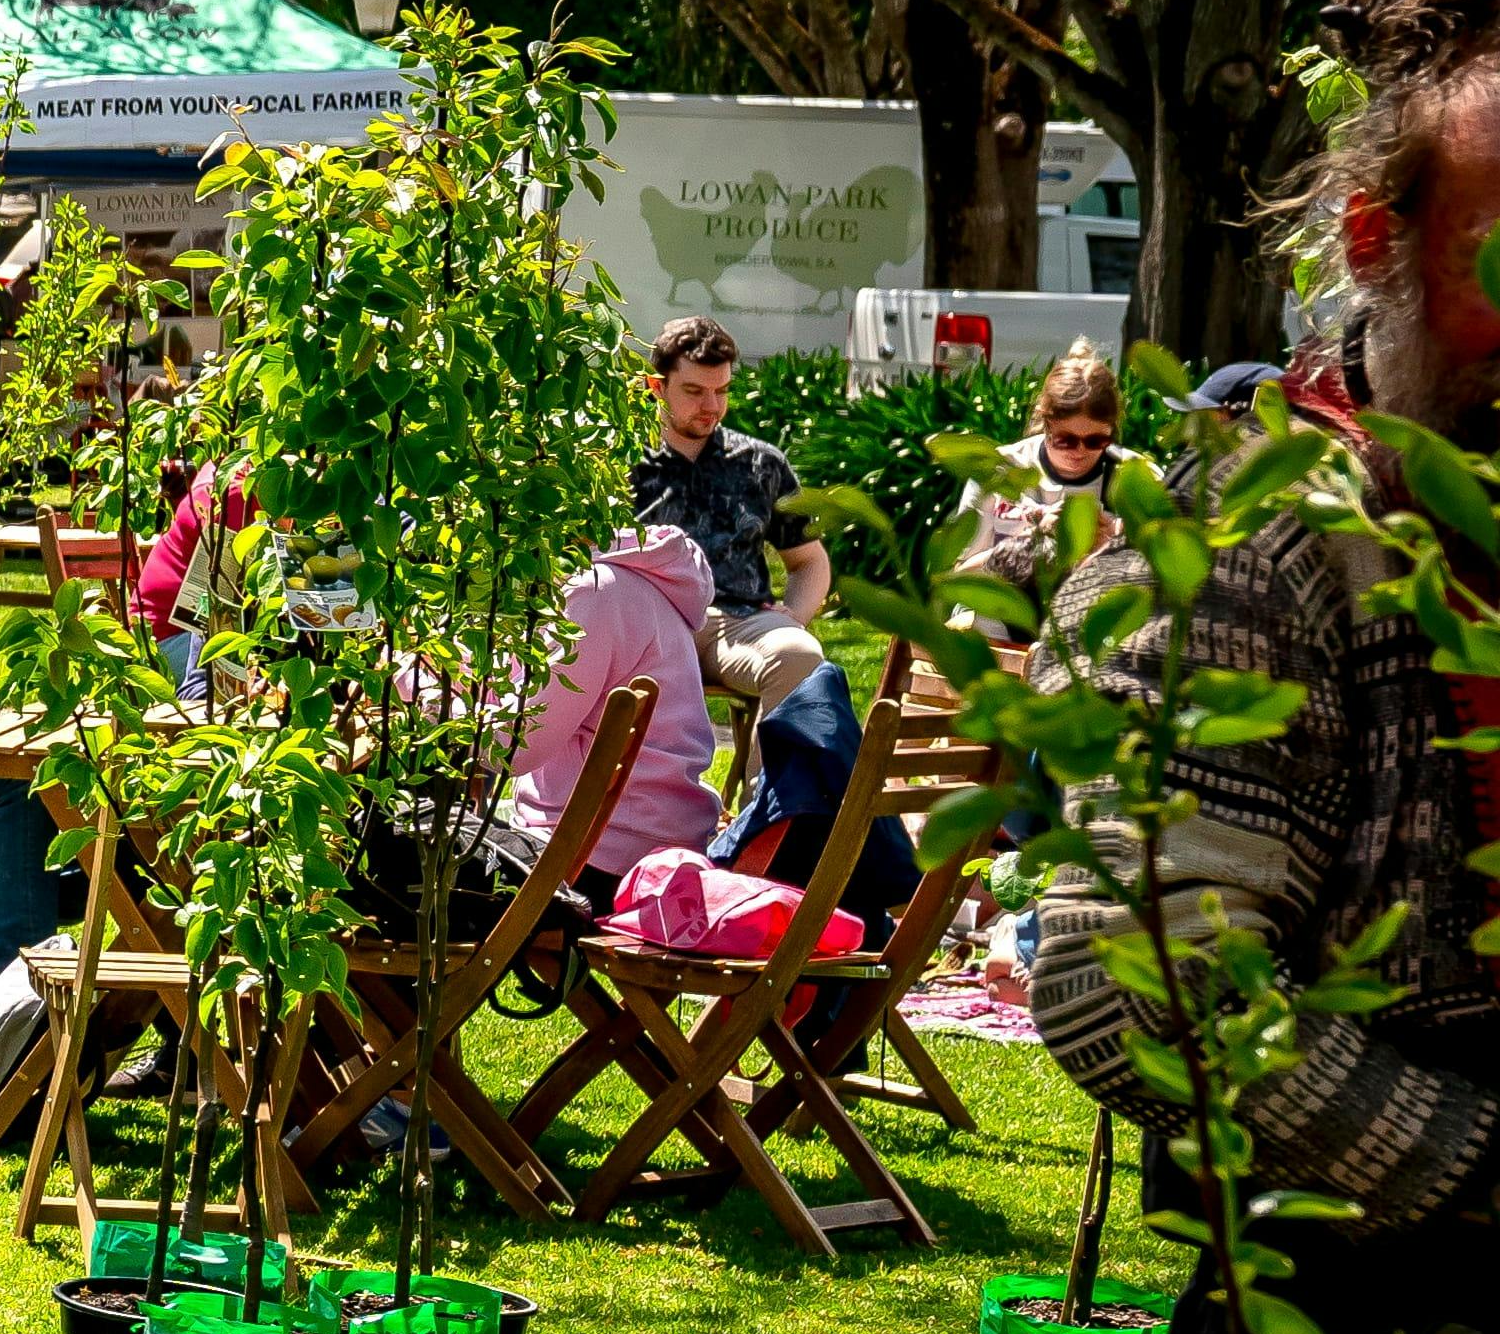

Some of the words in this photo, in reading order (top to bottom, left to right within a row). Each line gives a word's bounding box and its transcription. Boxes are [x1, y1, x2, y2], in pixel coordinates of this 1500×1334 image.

[37, 99, 95, 118] MEAT
[102, 97, 163, 116] FROM
[96, 192, 164, 212] LOWAN
[680, 180, 792, 206] LOWAN
[805, 185, 889, 209] PARK
[703, 215, 859, 243] PRODUCE
